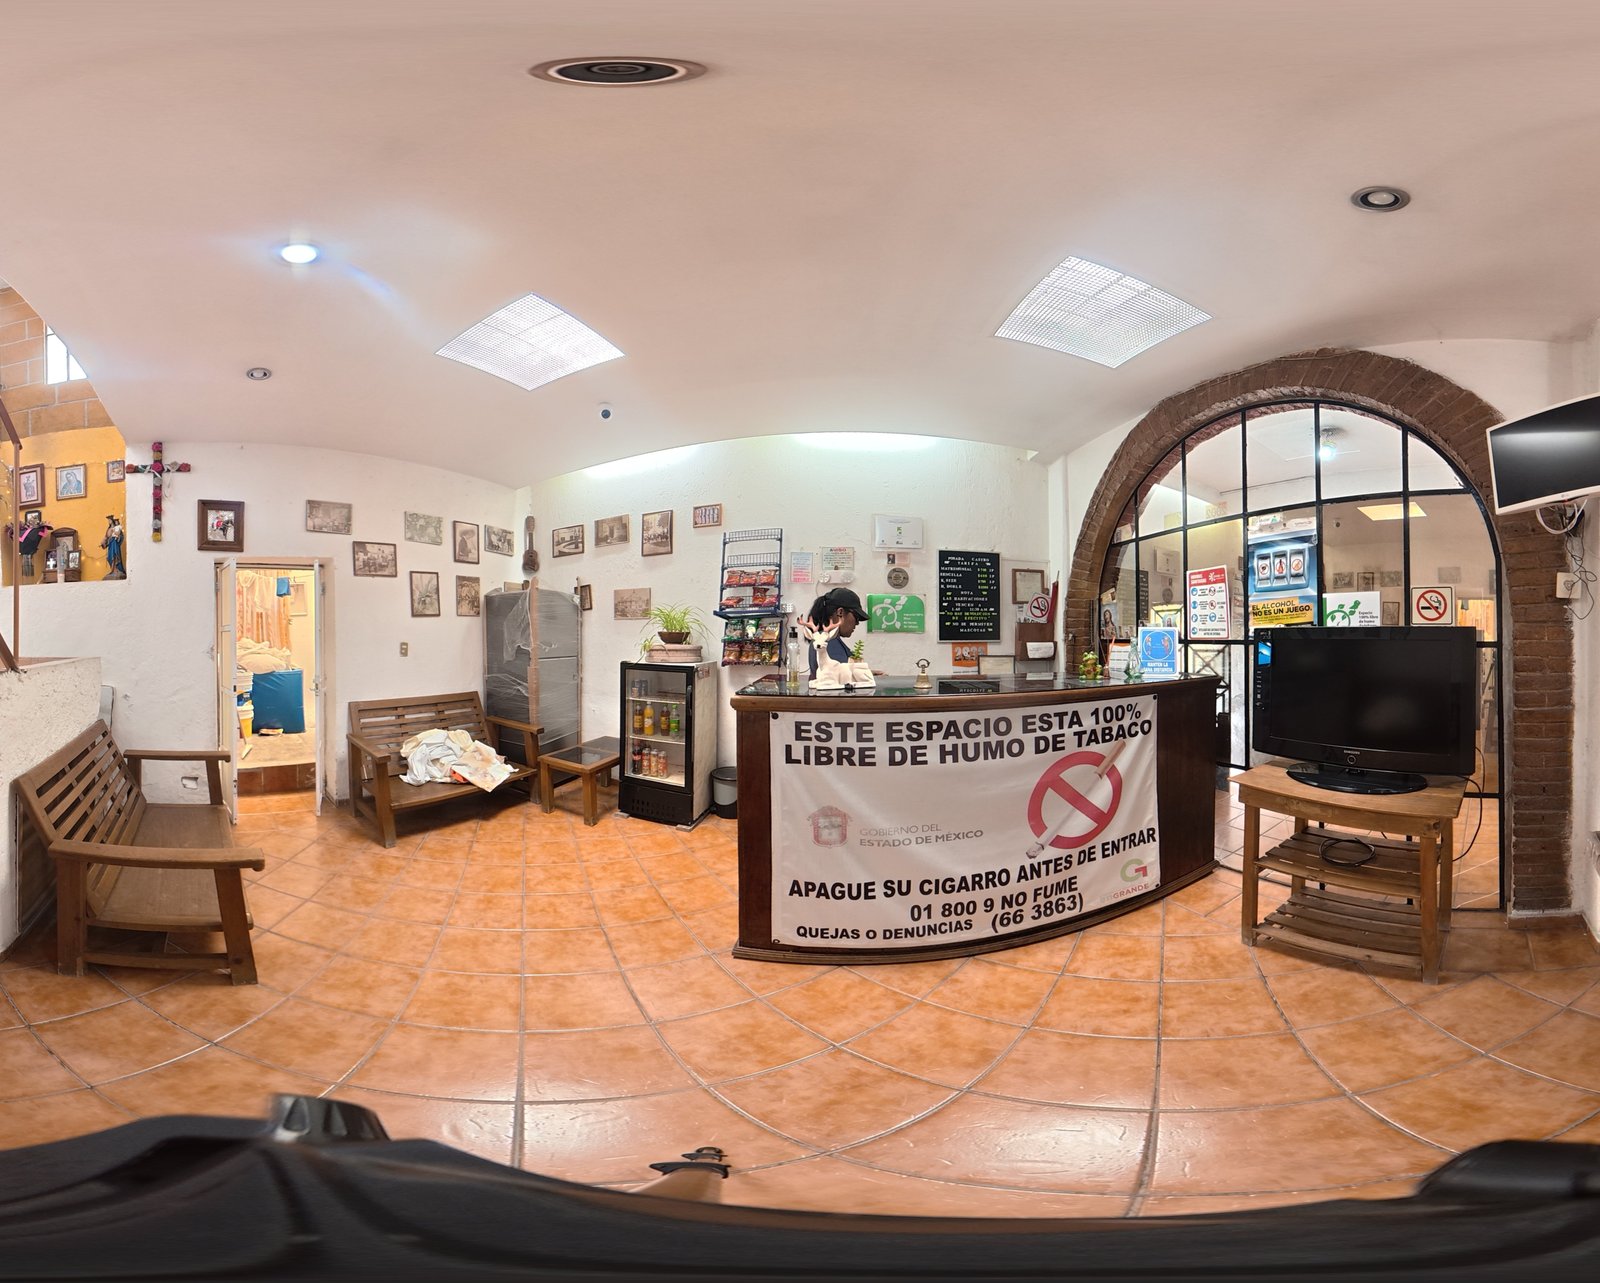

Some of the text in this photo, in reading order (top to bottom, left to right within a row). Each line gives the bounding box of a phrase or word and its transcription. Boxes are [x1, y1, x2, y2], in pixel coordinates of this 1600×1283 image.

[1261, 600, 1296, 610] ALCOHOL
[1285, 604, 1312, 613] JUEGO.
[794, 702, 1142, 742] ESTE ESPACIO ESTA 100%
[785, 719, 1152, 766] LIBRE DE HUMO DE TABACO
[860, 824, 942, 837] GOBIERNO DEL
[860, 829, 984, 848] ESTADO DE MÉXICO
[788, 827, 1157, 901] APAGUE SU CIGARRO ANTES DE ENTRAR
[910, 876, 1078, 922] 01 800 9 NO FUME
[991, 892, 1084, 933] (66 3863)
[796, 919, 973, 940] QUEJAS O DENUNCIAS
